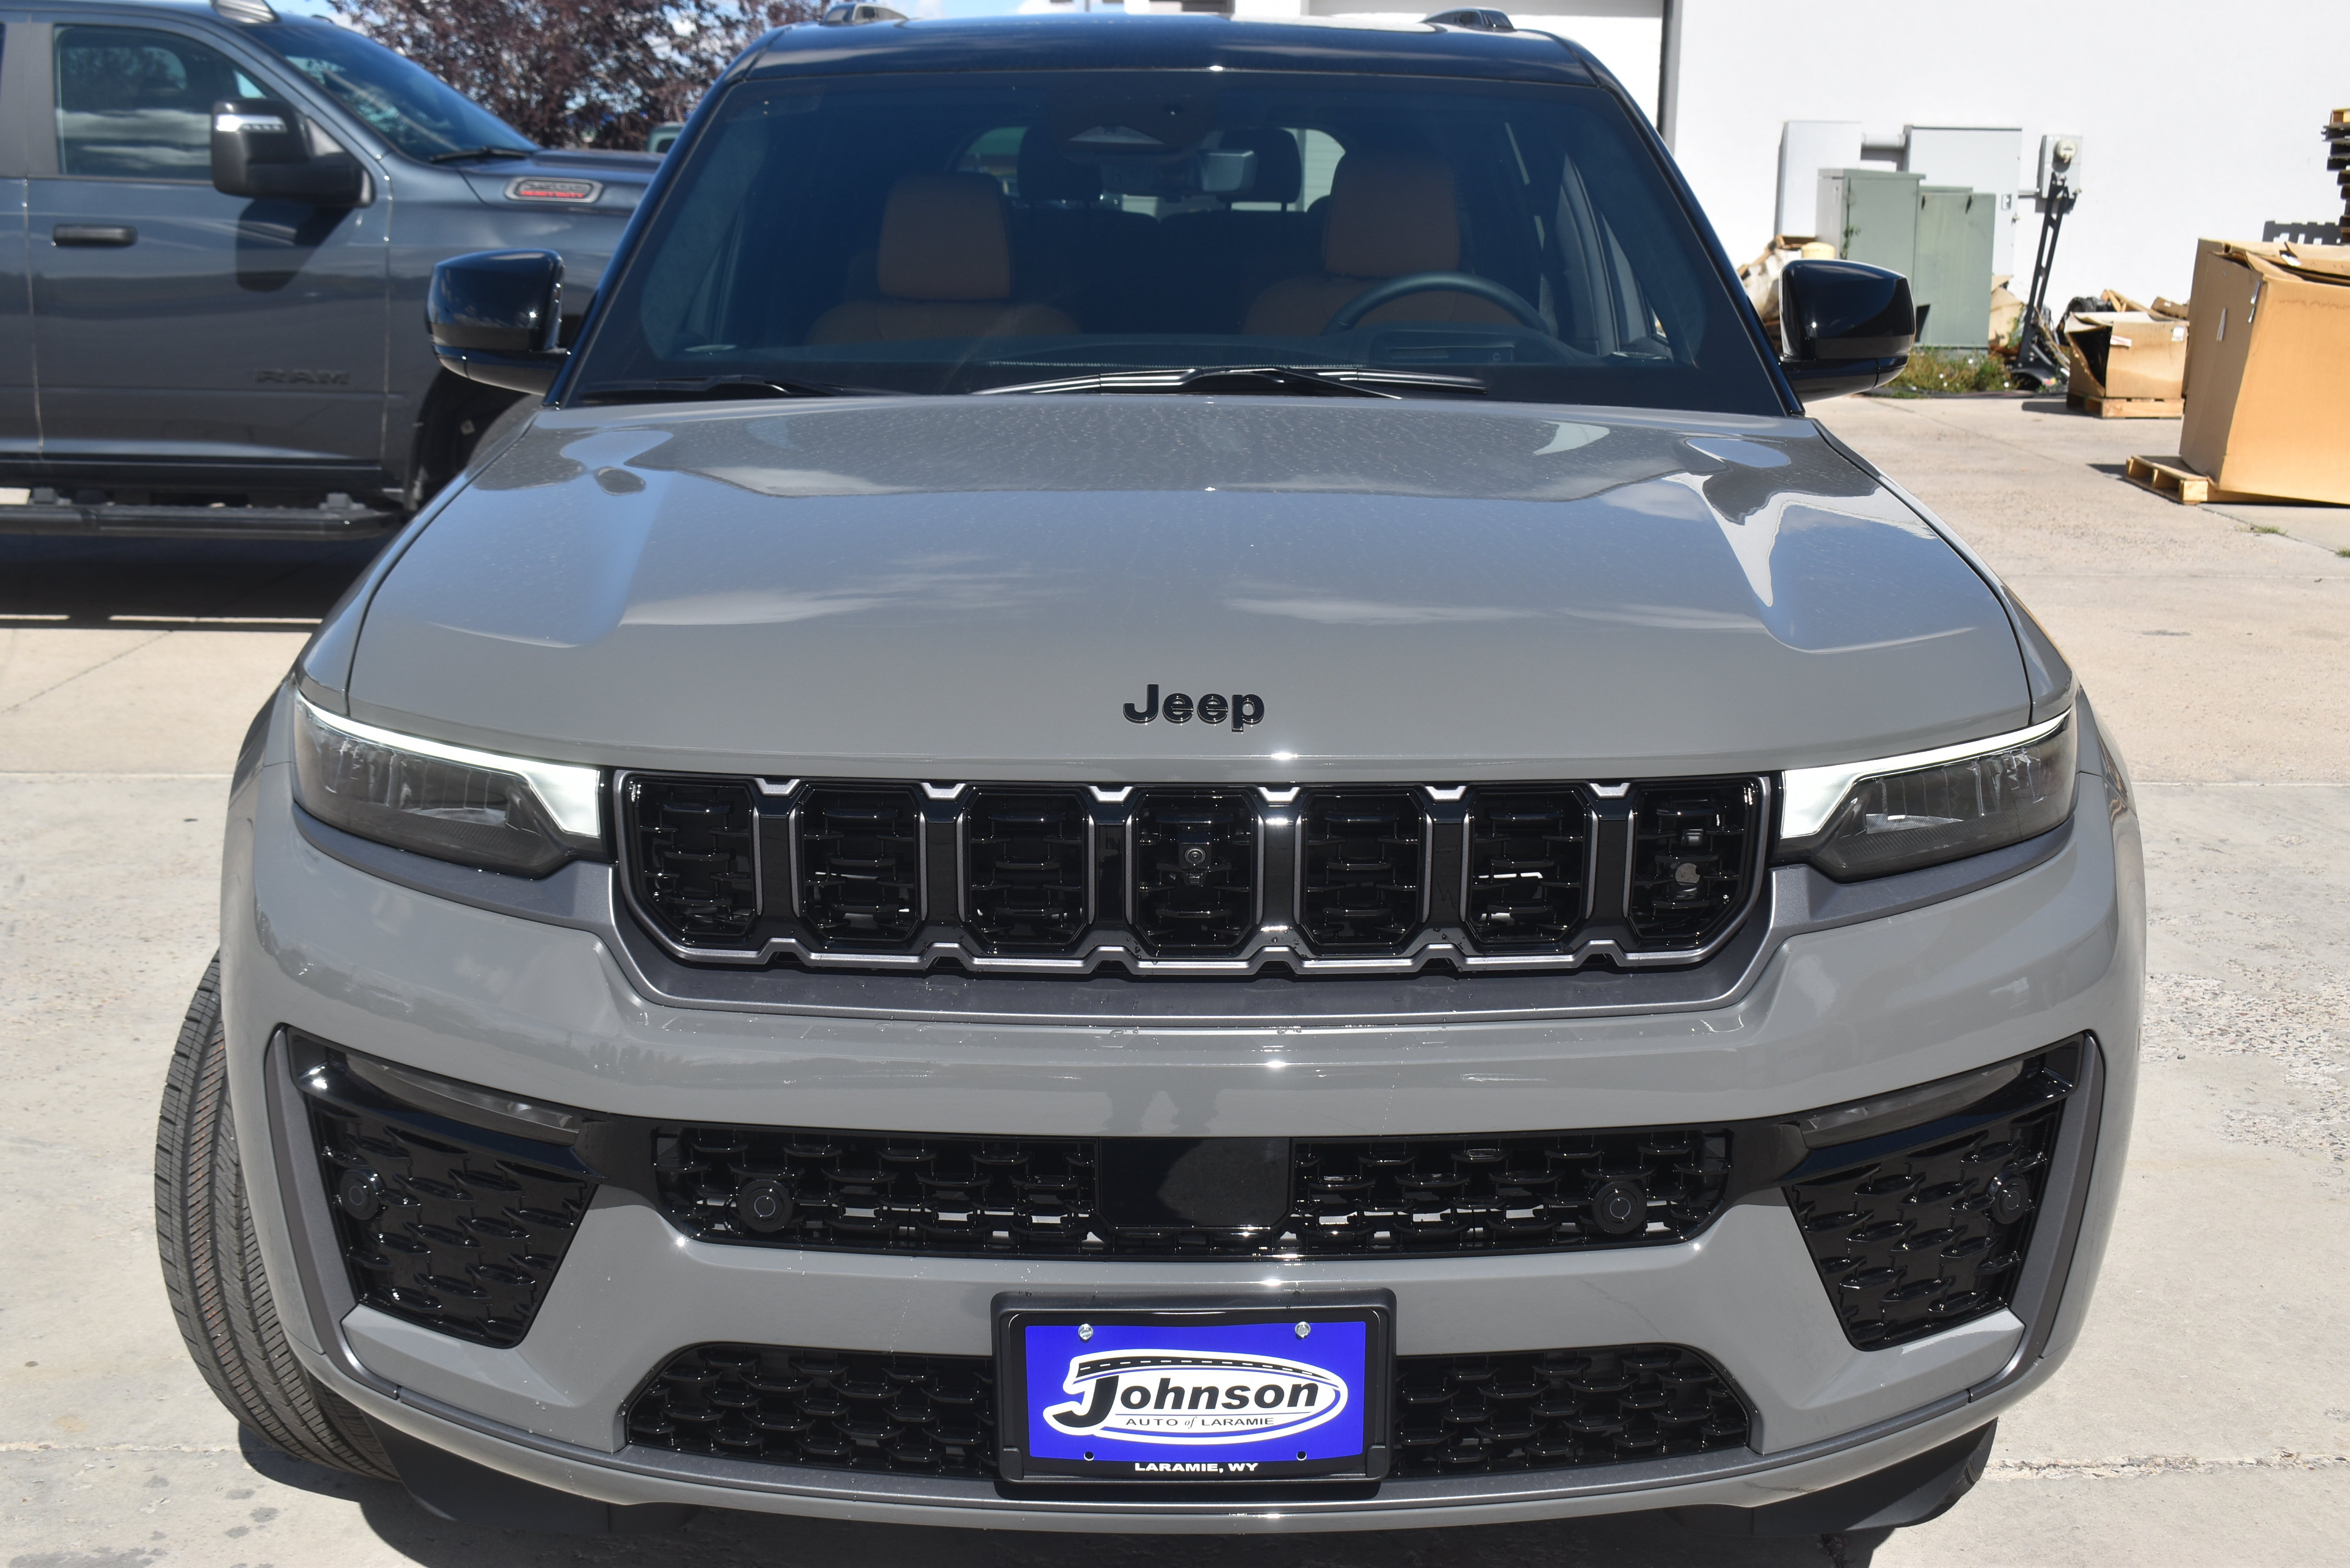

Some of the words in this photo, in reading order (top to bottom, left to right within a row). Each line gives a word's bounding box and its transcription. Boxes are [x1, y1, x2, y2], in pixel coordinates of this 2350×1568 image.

[256, 369, 350, 384] RAM
[1123, 684, 1264, 733] Jeep
[1052, 1375, 1319, 1428] Johnson
[1125, 1418, 1178, 1426] AUTO
[1184, 1416, 1196, 1429] of
[1201, 1417, 1275, 1426] LARAMIE
[1135, 1462, 1224, 1473] LARAMIE,
[1228, 1462, 1259, 1472] WY
